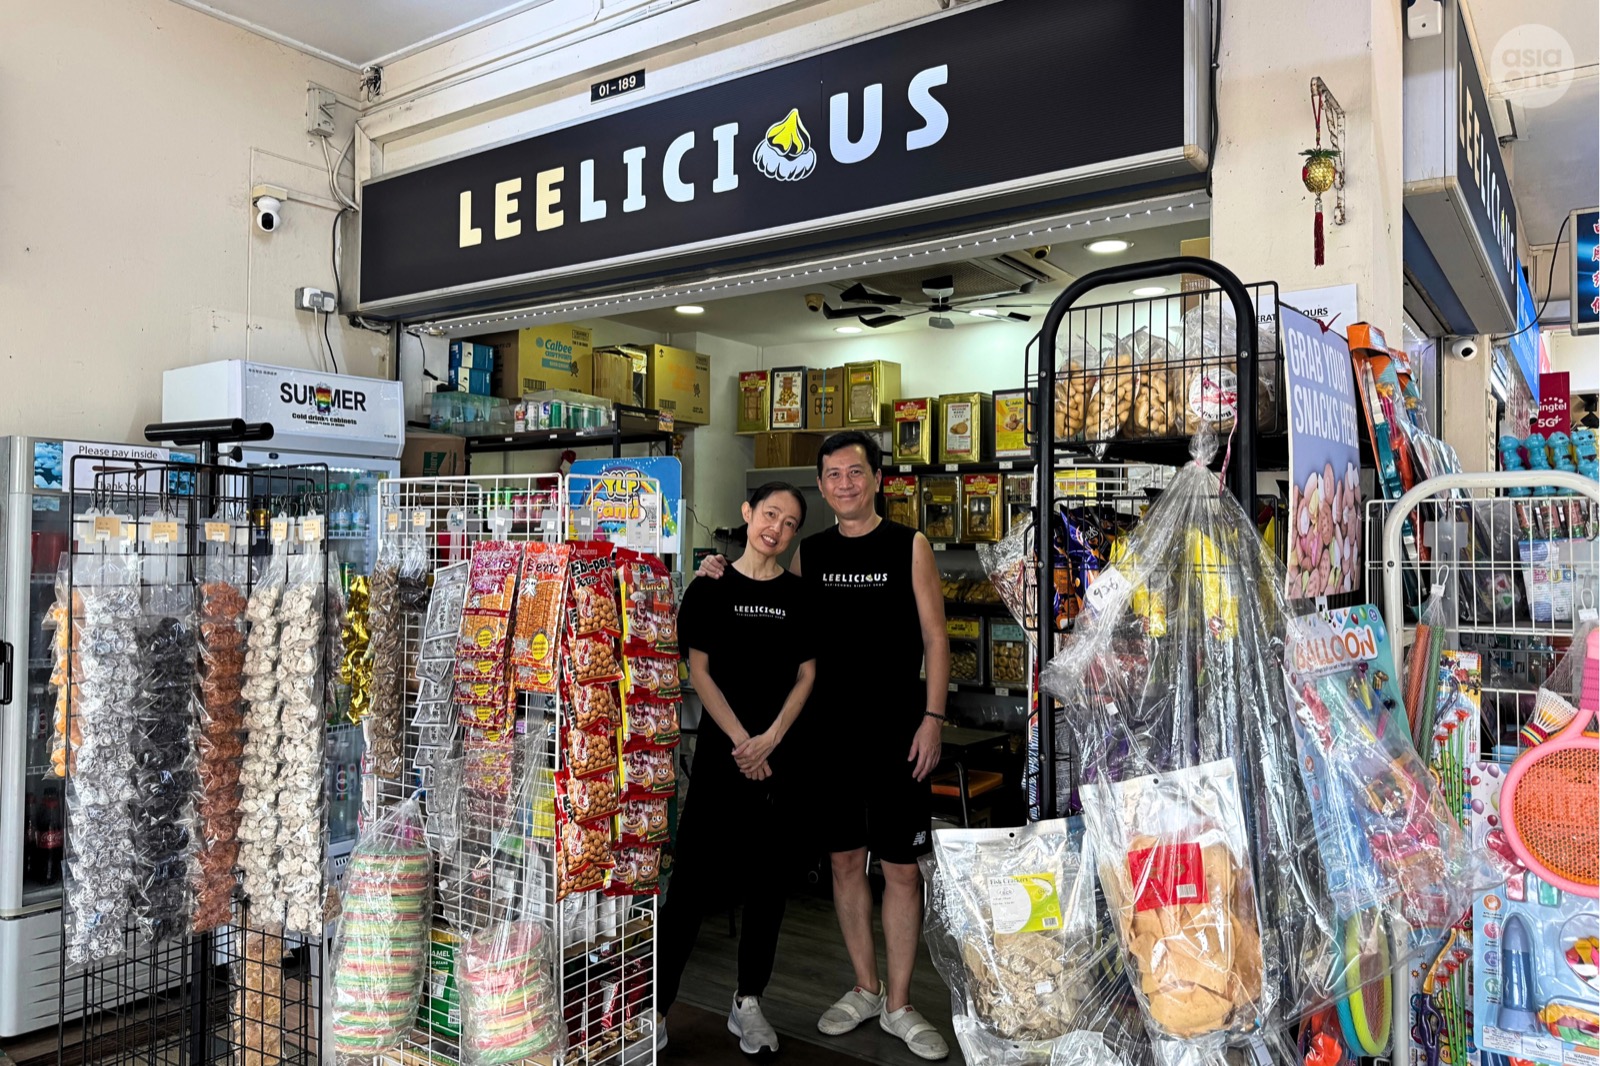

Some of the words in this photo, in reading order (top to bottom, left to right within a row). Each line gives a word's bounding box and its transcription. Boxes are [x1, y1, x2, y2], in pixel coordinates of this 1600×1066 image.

[599, 75, 636, 97] 01-189
[459, 64, 949, 248] LEELICIUS
[1458, 60, 1515, 286] LEELICIUS
[1302, 307, 1329, 317] OURS
[545, 339, 573, 353] Calbee
[1287, 327, 1324, 384] GRAB
[1321, 342, 1349, 396] YOUR
[1293, 384, 1341, 442] SNACKS
[1539, 402, 1567, 413] ingtel
[292, 412, 307, 420] Cold
[308, 414, 328, 422] drinks
[330, 417, 357, 425] cabinets
[78, 445, 110, 455] Please
[112, 449, 129, 458] pay
[131, 449, 158, 459] inside
[97, 480, 123, 491] hank
[602, 470, 641, 498] YLF
[527, 557, 560, 573] Bento
[822, 573, 888, 583] LEELICIUS
[734, 604, 786, 617] LEELICIUS
[1296, 628, 1375, 671] BALLOON
